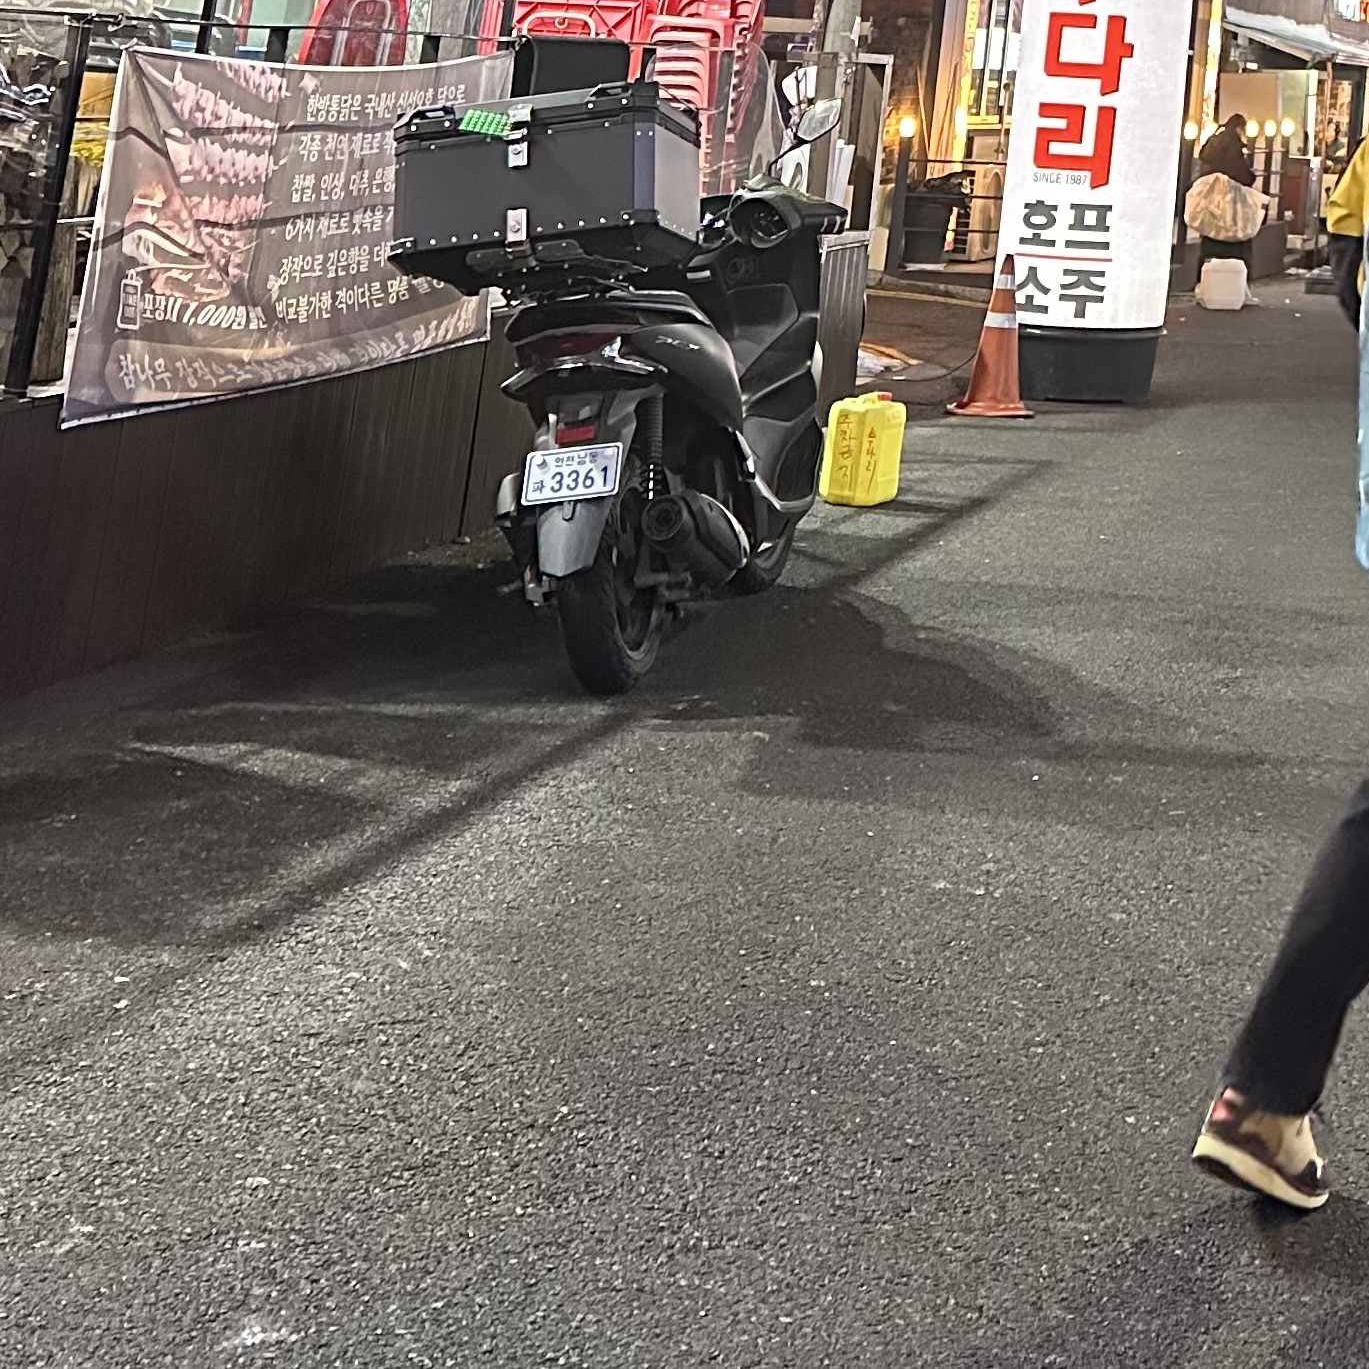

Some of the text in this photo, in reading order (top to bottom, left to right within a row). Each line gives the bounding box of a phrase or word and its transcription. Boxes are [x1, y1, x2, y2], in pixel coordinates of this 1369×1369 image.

[364, 92, 396, 121] 국내산
[299, 134, 322, 162] 각종
[324, 133, 347, 161] 천연
[348, 132, 381, 159] 재료로
[1033, 171, 1087, 185] SINCE 1987
[285, 214, 314, 243] 6가지
[317, 212, 349, 241] 재료로
[1020, 197, 1114, 251] 호프
[275, 291, 333, 325] 비교불가한
[335, 281, 385, 316] 격이다른
[1015, 269, 1106, 320] 소주
[182, 300, 247, 330] 1,000원
[119, 353, 173, 391] 참나무
[550, 465, 608, 494] 3361
